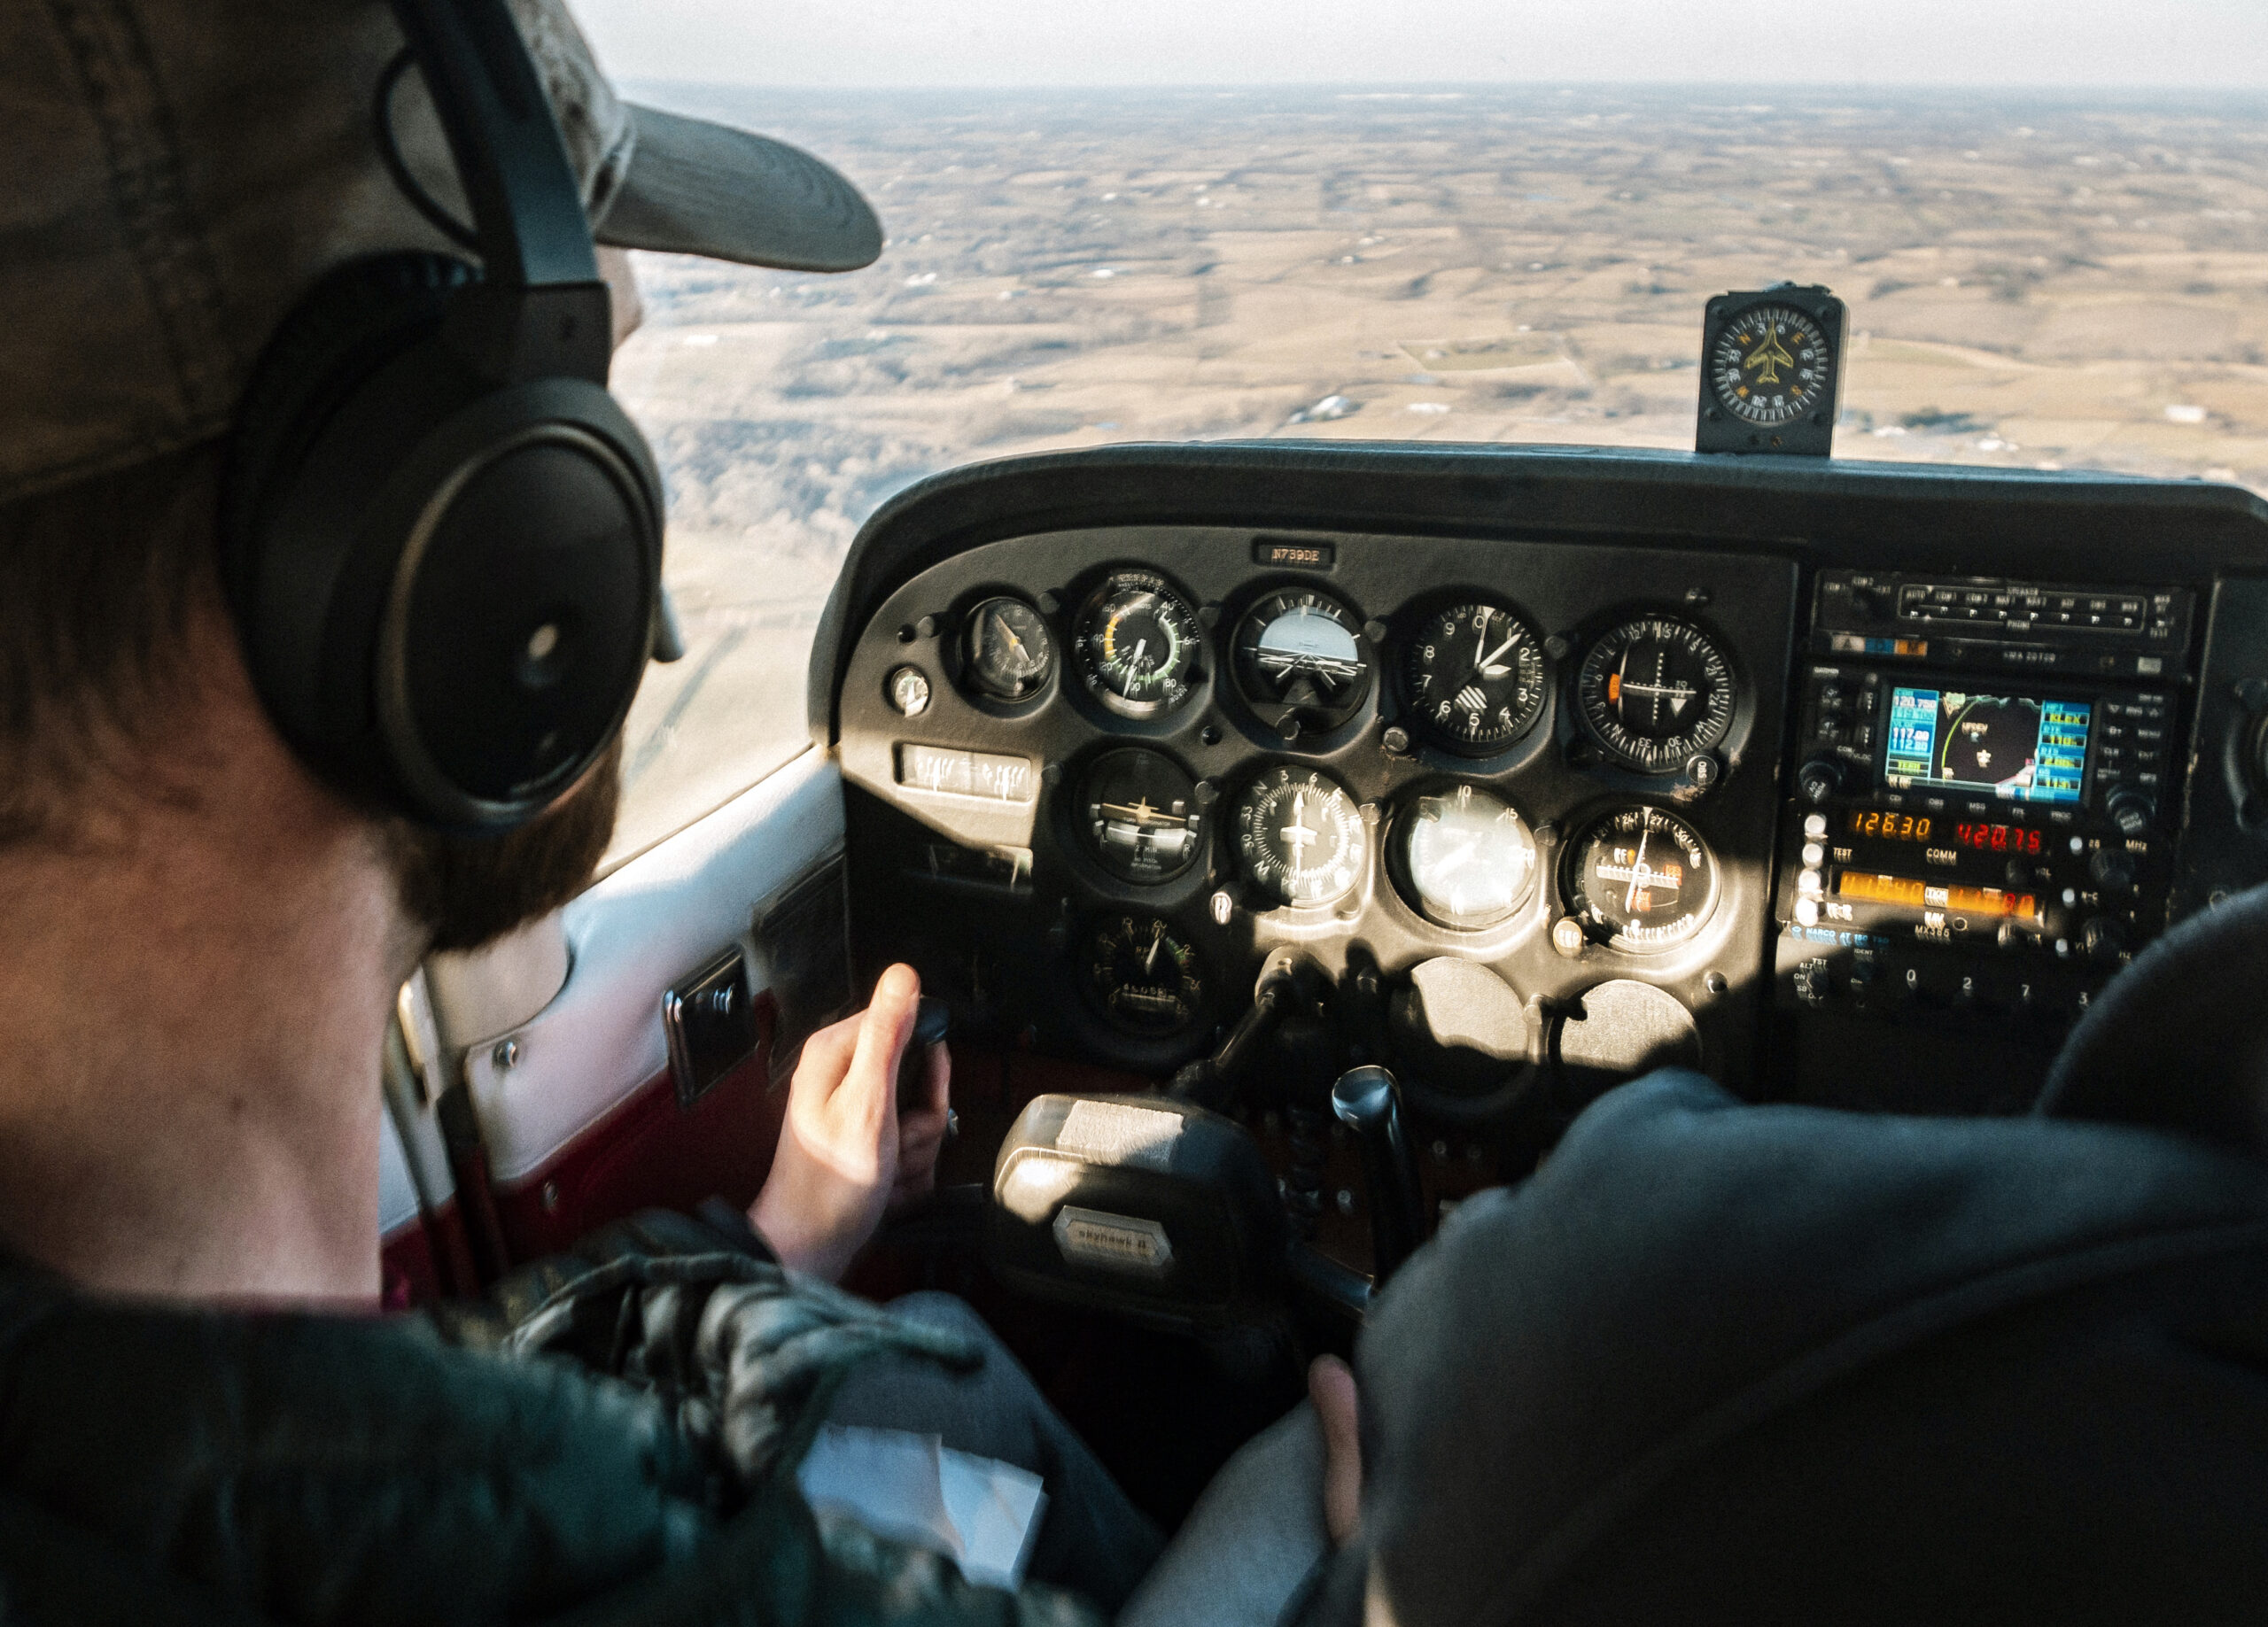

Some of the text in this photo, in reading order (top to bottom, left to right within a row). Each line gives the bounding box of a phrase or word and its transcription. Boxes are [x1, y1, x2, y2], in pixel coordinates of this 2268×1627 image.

[1739, 333, 1751, 345] N
[1791, 331, 1805, 345] E
[1271, 548, 1320, 562] N739DE
[1445, 622, 1456, 636] 9
[1474, 615, 1485, 630] 0
[1425, 645, 1435, 659] 8
[1519, 647, 1531, 662] 2
[1165, 678, 1177, 688] 80
[1422, 674, 1433, 688] 7
[1518, 687, 1528, 701] 3
[1708, 693, 1720, 706] 24
[1440, 700, 1451, 714] 6
[1500, 706, 1511, 719] 4
[1469, 712, 1480, 726] 5
[1696, 721, 1707, 733] W
[1638, 737, 1652, 748] 33
[1668, 735, 1682, 748] 30
[1697, 761, 1707, 779] OBS
[1309, 772, 1318, 783] 6
[1457, 785, 1472, 798] 10
[1929, 798, 1944, 807] OBS
[1969, 802, 1986, 811] MSG
[1506, 807, 1518, 820] 15
[1650, 816, 1663, 825] 27
[1855, 813, 1930, 837] 126.30
[1675, 830, 1688, 841] 30
[1833, 847, 1852, 860] TEST
[1926, 848, 1957, 863] COMM
[1806, 928, 1836, 939] NARCO
[1840, 932, 1852, 941] AT
[1813, 957, 1828, 966] TST
[1963, 977, 1972, 990] 2
[2021, 984, 2031, 997] 7
[2078, 992, 2088, 1006] 3
